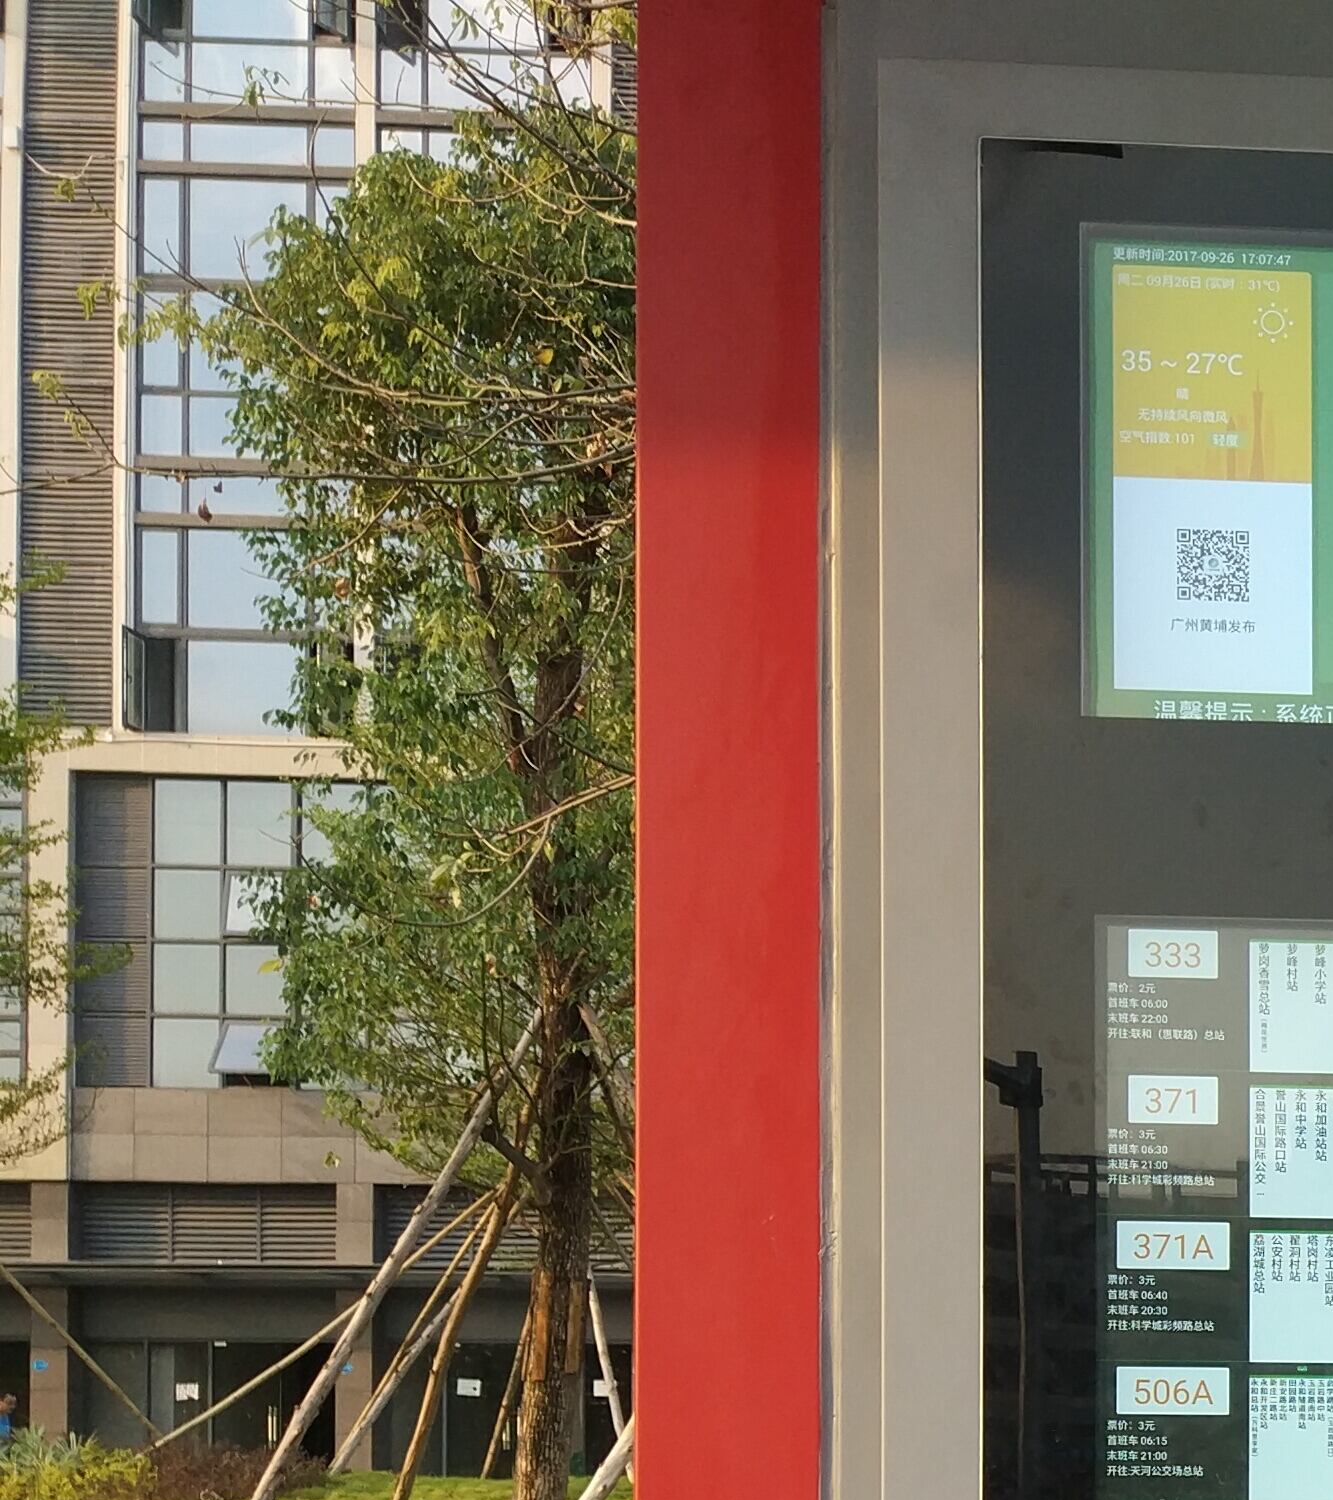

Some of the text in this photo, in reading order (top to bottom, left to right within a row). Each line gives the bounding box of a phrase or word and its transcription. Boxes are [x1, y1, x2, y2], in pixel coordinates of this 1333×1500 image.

[1113, 247, 1291, 266] 更新时间:2017-09-26 17:07:47
[1121, 350, 1152, 372] 35
[1170, 618, 1256, 633] 广州黄埔发布
[1145, 942, 1200, 968] 333
[1108, 998, 1168, 1008] 首班车 06:00
[1108, 1013, 1168, 1024] 末班车 22:00
[1145, 1088, 1197, 1114] 371
[1108, 1144, 1168, 1154] 首班车 06:30
[1108, 1159, 1168, 1170] 末班车 21:00
[1134, 1233, 1214, 1259] 371A
[1107, 1290, 1168, 1300] 首班车 06:40
[1107, 1305, 1168, 1315] 末班车 20:30
[1134, 1379, 1214, 1405] 506A
[1107, 1436, 1168, 1446] 首班车 06:15
[1107, 1451, 1168, 1461] 末班车 21:00
